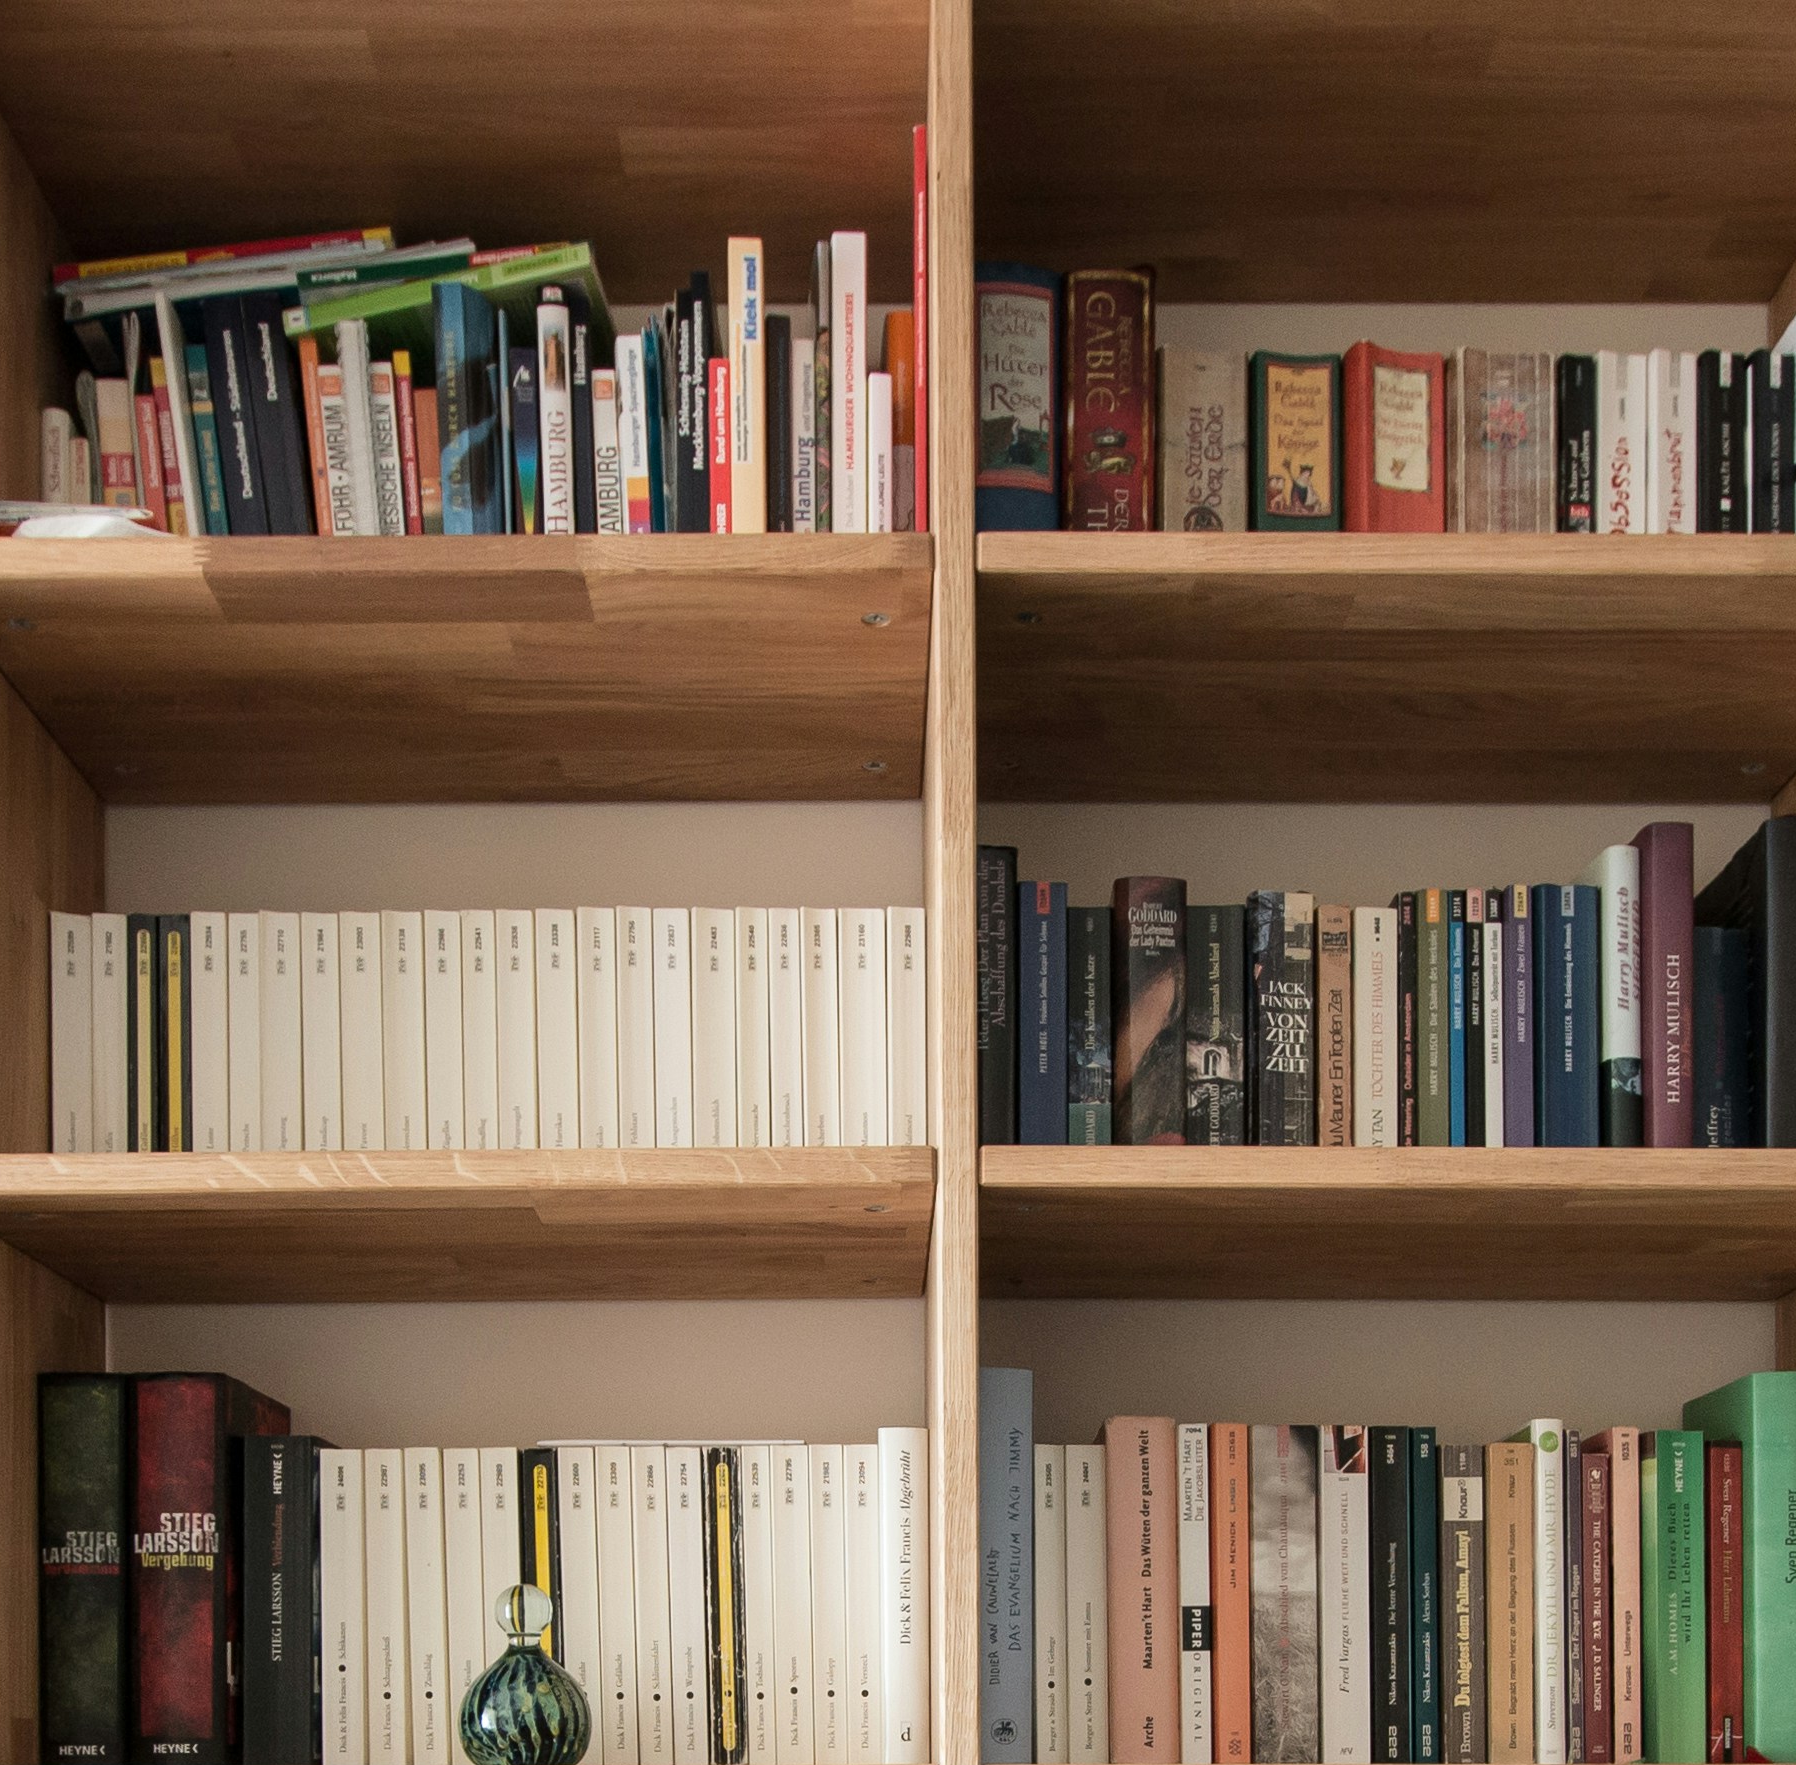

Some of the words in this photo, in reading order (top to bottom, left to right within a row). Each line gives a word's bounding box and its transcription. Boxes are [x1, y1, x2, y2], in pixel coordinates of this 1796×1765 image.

[743, 258, 757, 290] mal
[744, 298, 757, 340] Kiek
[573, 325, 586, 384] Hamburg
[844, 293, 854, 393] WOHNQUARTIERE
[1085, 291, 1116, 413] GABLÉ
[259, 323, 278, 401] Deutschland
[678, 320, 692, 436] Schleswig-Holstein
[691, 301, 706, 470] Mecklenburg-Vorpommern
[324, 403, 347, 470] AMRUM
[845, 398, 854, 470] HAMBURGER
[548, 411, 570, 533] HAMBURG
[794, 437, 813, 521] Hamburg
[329, 485, 352, 531] FÖHR
[1616, 887, 1630, 954] Mulisch
[1269, 981, 1305, 994] JACK
[1370, 952, 1384, 1008] HIMMELS
[1617, 960, 1632, 1010] Harry
[1666, 954, 1680, 1036] MULISCH
[1261, 994, 1313, 1009] FINNEY
[1265, 1012, 1306, 1026] VON
[1265, 1026, 1308, 1042] ZEIT
[1371, 1012, 1384, 1034] DES
[1265, 1056, 1308, 1072] ZEIT
[1271, 1042, 1305, 1057] ZU
[1368, 1040, 1384, 1099] TÖCHTER
[1666, 1041, 1680, 1102] HARRY
[1371, 1110, 1384, 1134] TAN
[1138, 1430, 1150, 1455] Welt
[899, 1449, 913, 1514] Abgebrüht
[1140, 1458, 1153, 1496] ganzen
[160, 1512, 217, 1531] STIEG
[1139, 1498, 1151, 1517] der
[135, 1532, 219, 1554] LARSSON
[900, 1517, 912, 1565] Francis
[1139, 1519, 1152, 1556] Wüten
[142, 1553, 214, 1570] Vergebung
[1140, 1558, 1151, 1577] Das
[900, 1568, 912, 1600] Felix
[1141, 1587, 1153, 1613] Hart
[901, 1603, 911, 1613] &
[900, 1616, 912, 1644] Dick
[154, 1743, 190, 1754] HEYNE
[1143, 1716, 1154, 1748] Arche
